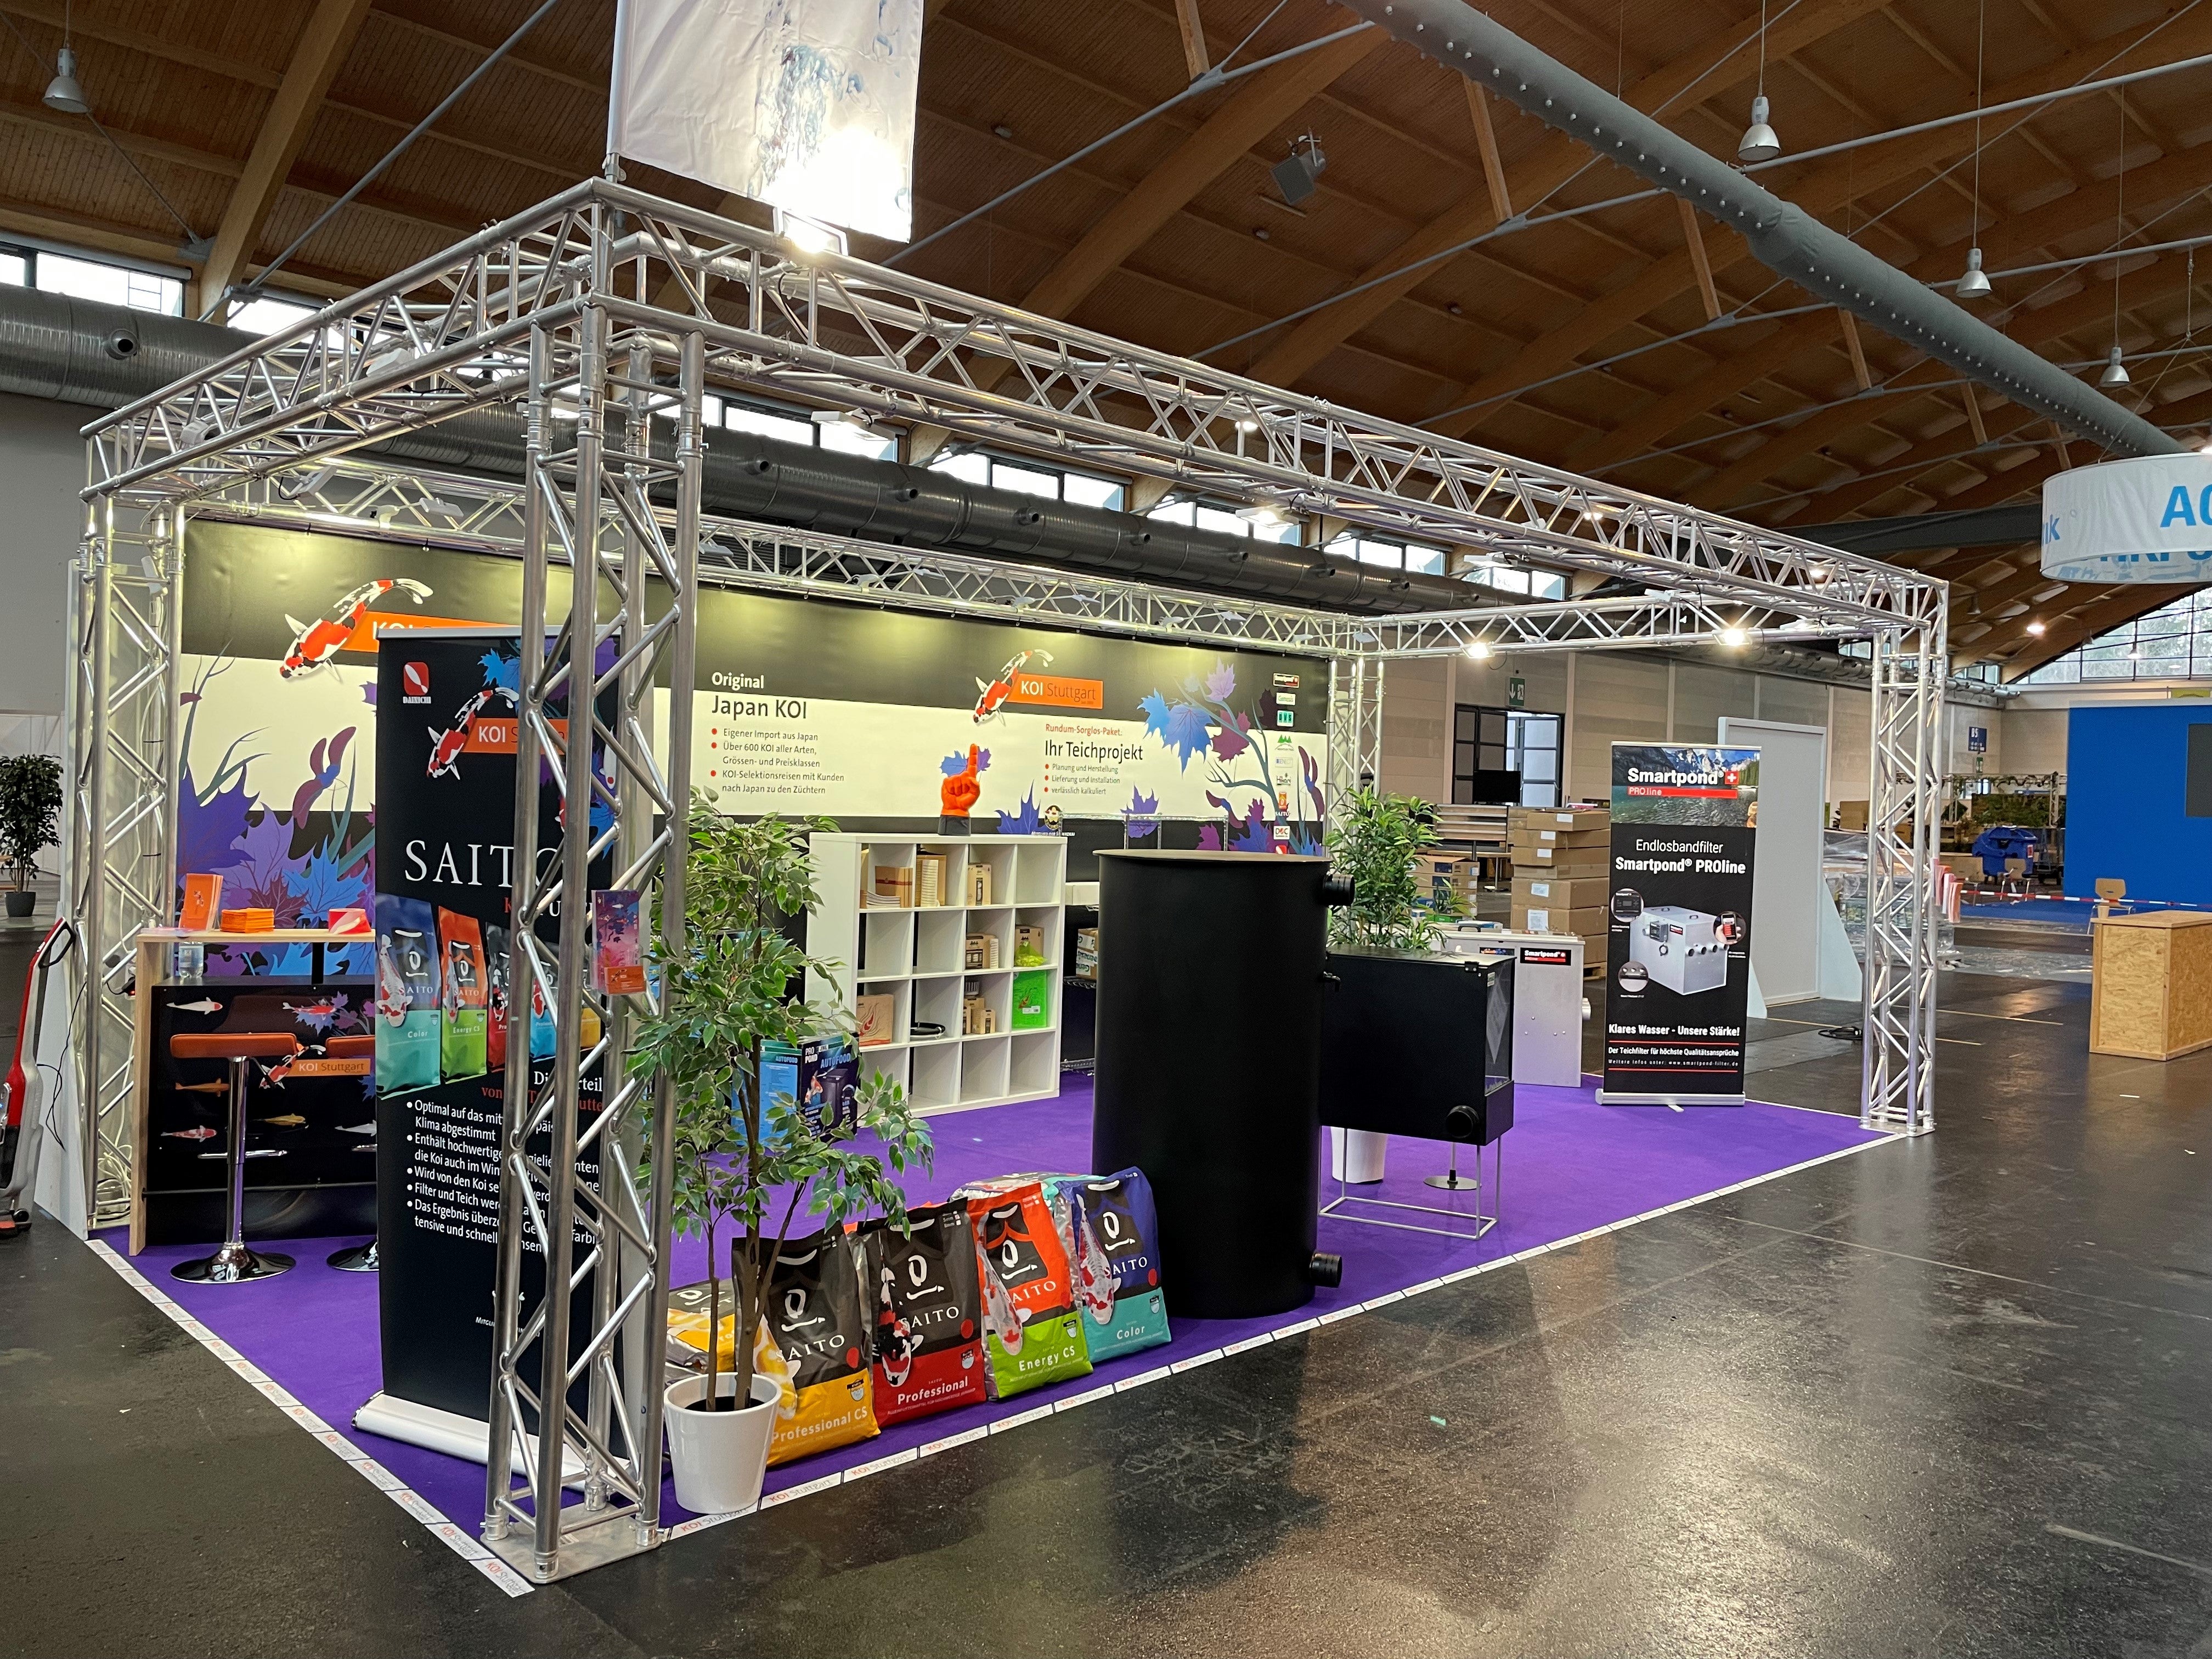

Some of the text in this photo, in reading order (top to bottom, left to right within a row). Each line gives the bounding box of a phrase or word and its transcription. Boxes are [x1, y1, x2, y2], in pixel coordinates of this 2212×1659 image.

[712, 672, 764, 691] Original
[1021, 680, 1096, 702] KOI Stuttgart
[712, 695, 807, 720] Japan KOI
[478, 726, 506, 743] KOI
[723, 729, 752, 738] Eigener
[755, 730, 780, 741] Import
[797, 733, 818, 742] Japan
[723, 741, 817, 755] Über 600 KOI aller Arten,
[1045, 740, 1143, 764] Ihr Teichprojekt
[723, 755, 820, 768] Grössen- und Preisklassen
[1052, 763, 1074, 772] Planung
[1087, 765, 1118, 774] Herstellung
[722, 770, 844, 781] KOI-Selektionsreisen mit Kunden
[1052, 775, 1077, 784] Lieferung
[742, 785, 764, 794] Japan
[793, 785, 826, 794] Züchtern
[1636, 839, 1724, 854] Endlosbandfilter
[1696, 860, 1746, 874] PROline
[408, 1030, 428, 1039] Color
[1609, 1024, 1636, 1034] Klares
[1638, 1025, 1669, 1035] Wasser
[1678, 1026, 1708, 1035] Unsere
[1709, 1026, 1740, 1036] Stärke!
[805, 1046, 815, 1056] PRO
[805, 1053, 818, 1064] POND
[1684, 1048, 1739, 1057] Qualitätsansprüche
[775, 1056, 798, 1064] AUTOFOOD
[820, 1053, 851, 1069] AUTOFOOD
[298, 1062, 365, 1074] KOI Stuttgart
[481, 1087, 503, 1099] von
[415, 1100, 449, 1116] Optimal
[451, 1107, 466, 1119] auf
[467, 1109, 483, 1122] das
[415, 1116, 496, 1141] Klima abgestimmt
[415, 1133, 445, 1149] Enthält
[415, 1149, 428, 1162] die
[431, 1152, 443, 1165] Koi
[444, 1158, 465, 1170] auch
[467, 1160, 479, 1172] im
[414, 1166, 435, 1180] Wird
[437, 1172, 452, 1184] von
[454, 1174, 470, 1187] den
[472, 1178, 487, 1190] Koi
[415, 1182, 437, 1197] Filter
[438, 1189, 454, 1201] und
[455, 1191, 478, 1206] Teich
[415, 1199, 431, 1212] Das
[433, 1203, 469, 1221] Ergebnis
[414, 1215, 445, 1232] tensive
[447, 1225, 463, 1237] und
[1103, 1256, 1148, 1276] SAITO
[1005, 1280, 1057, 1305] SAITO
[900, 1306, 960, 1328] SAITO
[1116, 1325, 1146, 1340] Color
[775, 1334, 845, 1362] SAITO
[1019, 1353, 1059, 1373] Energy
[1063, 1345, 1076, 1358] CS
[898, 1375, 969, 1405] Professional
[771, 1406, 868, 1444] Professional CS
[926, 1442, 944, 1451] KOI
[851, 1465, 870, 1476] KOI
[769, 1491, 789, 1503] KOI
[680, 1520, 702, 1533] KOI
